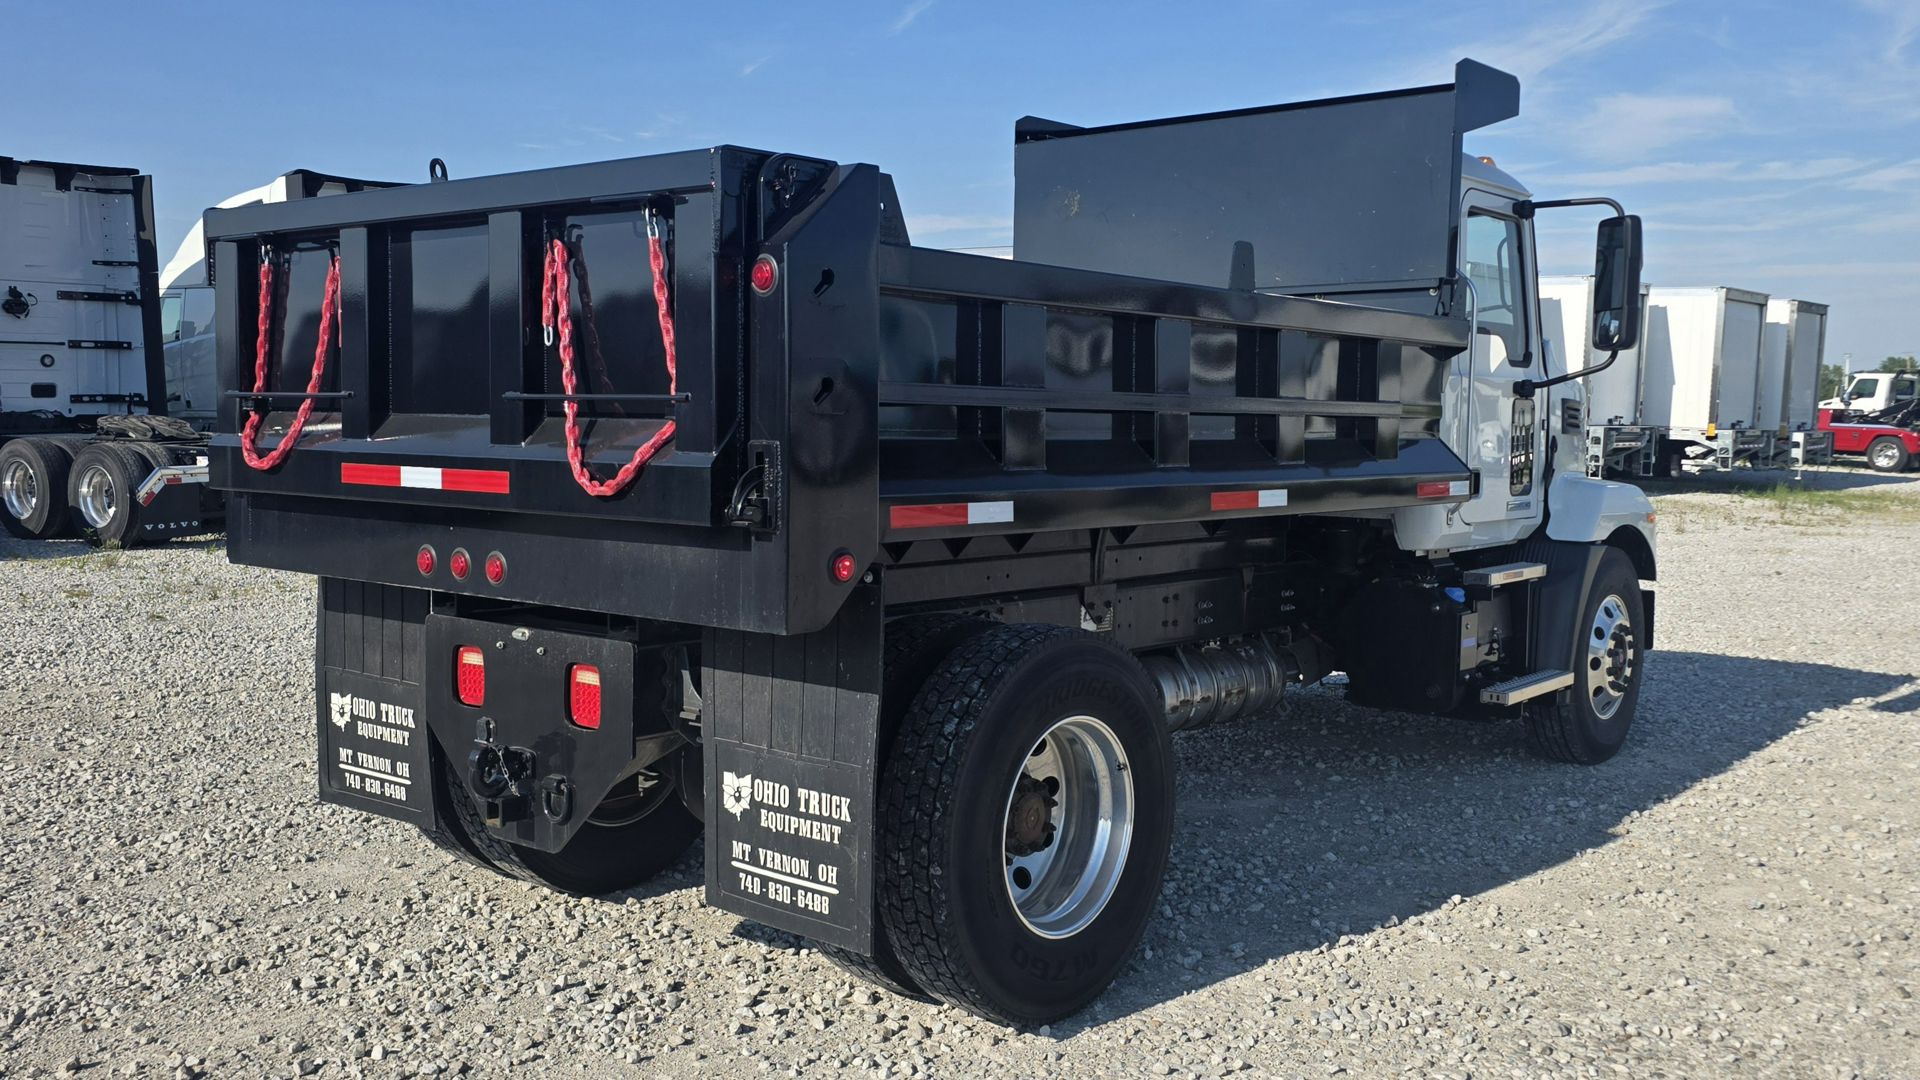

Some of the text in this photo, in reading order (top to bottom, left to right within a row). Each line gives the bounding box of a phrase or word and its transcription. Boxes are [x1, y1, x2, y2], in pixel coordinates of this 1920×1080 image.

[144, 521, 199, 530] VOLVO
[353, 697, 416, 728] OHIO TRUCK
[357, 721, 410, 746] EQUIPMENT
[397, 761, 410, 778] OH
[344, 773, 407, 801] 740-830-6488
[753, 779, 851, 822] OHIO TRUCK
[760, 809, 842, 845] EQUIPMENT
[758, 847, 813, 880] VERNON,
[818, 864, 838, 885] OH
[739, 872, 830, 915] 740-830-6488
